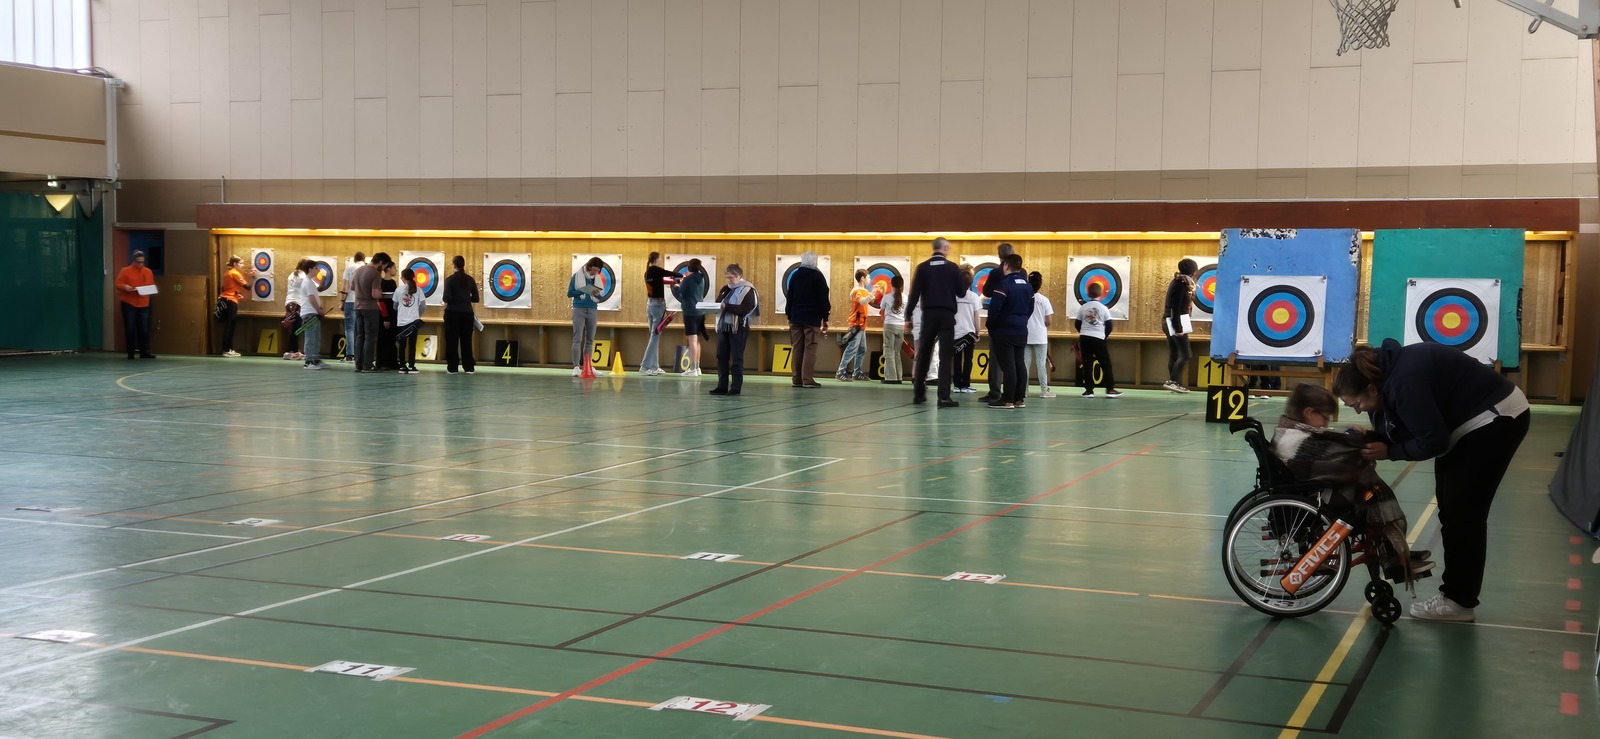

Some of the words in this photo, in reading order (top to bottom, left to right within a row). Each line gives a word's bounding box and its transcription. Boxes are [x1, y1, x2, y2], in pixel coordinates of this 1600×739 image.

[268, 332, 274, 351] 1
[337, 337, 346, 358] 2
[421, 337, 431, 357] 3
[502, 343, 512, 364] 4
[592, 343, 602, 363] 5
[680, 348, 690, 371] 6
[782, 347, 792, 369] 7
[977, 352, 989, 376] 9
[1204, 359, 1225, 385] 11
[1211, 389, 1245, 420] 12
[1297, 529, 1342, 575] FIVICS
[959, 574, 993, 582] 12
[340, 664, 385, 675] 11
[690, 700, 738, 714] 12
